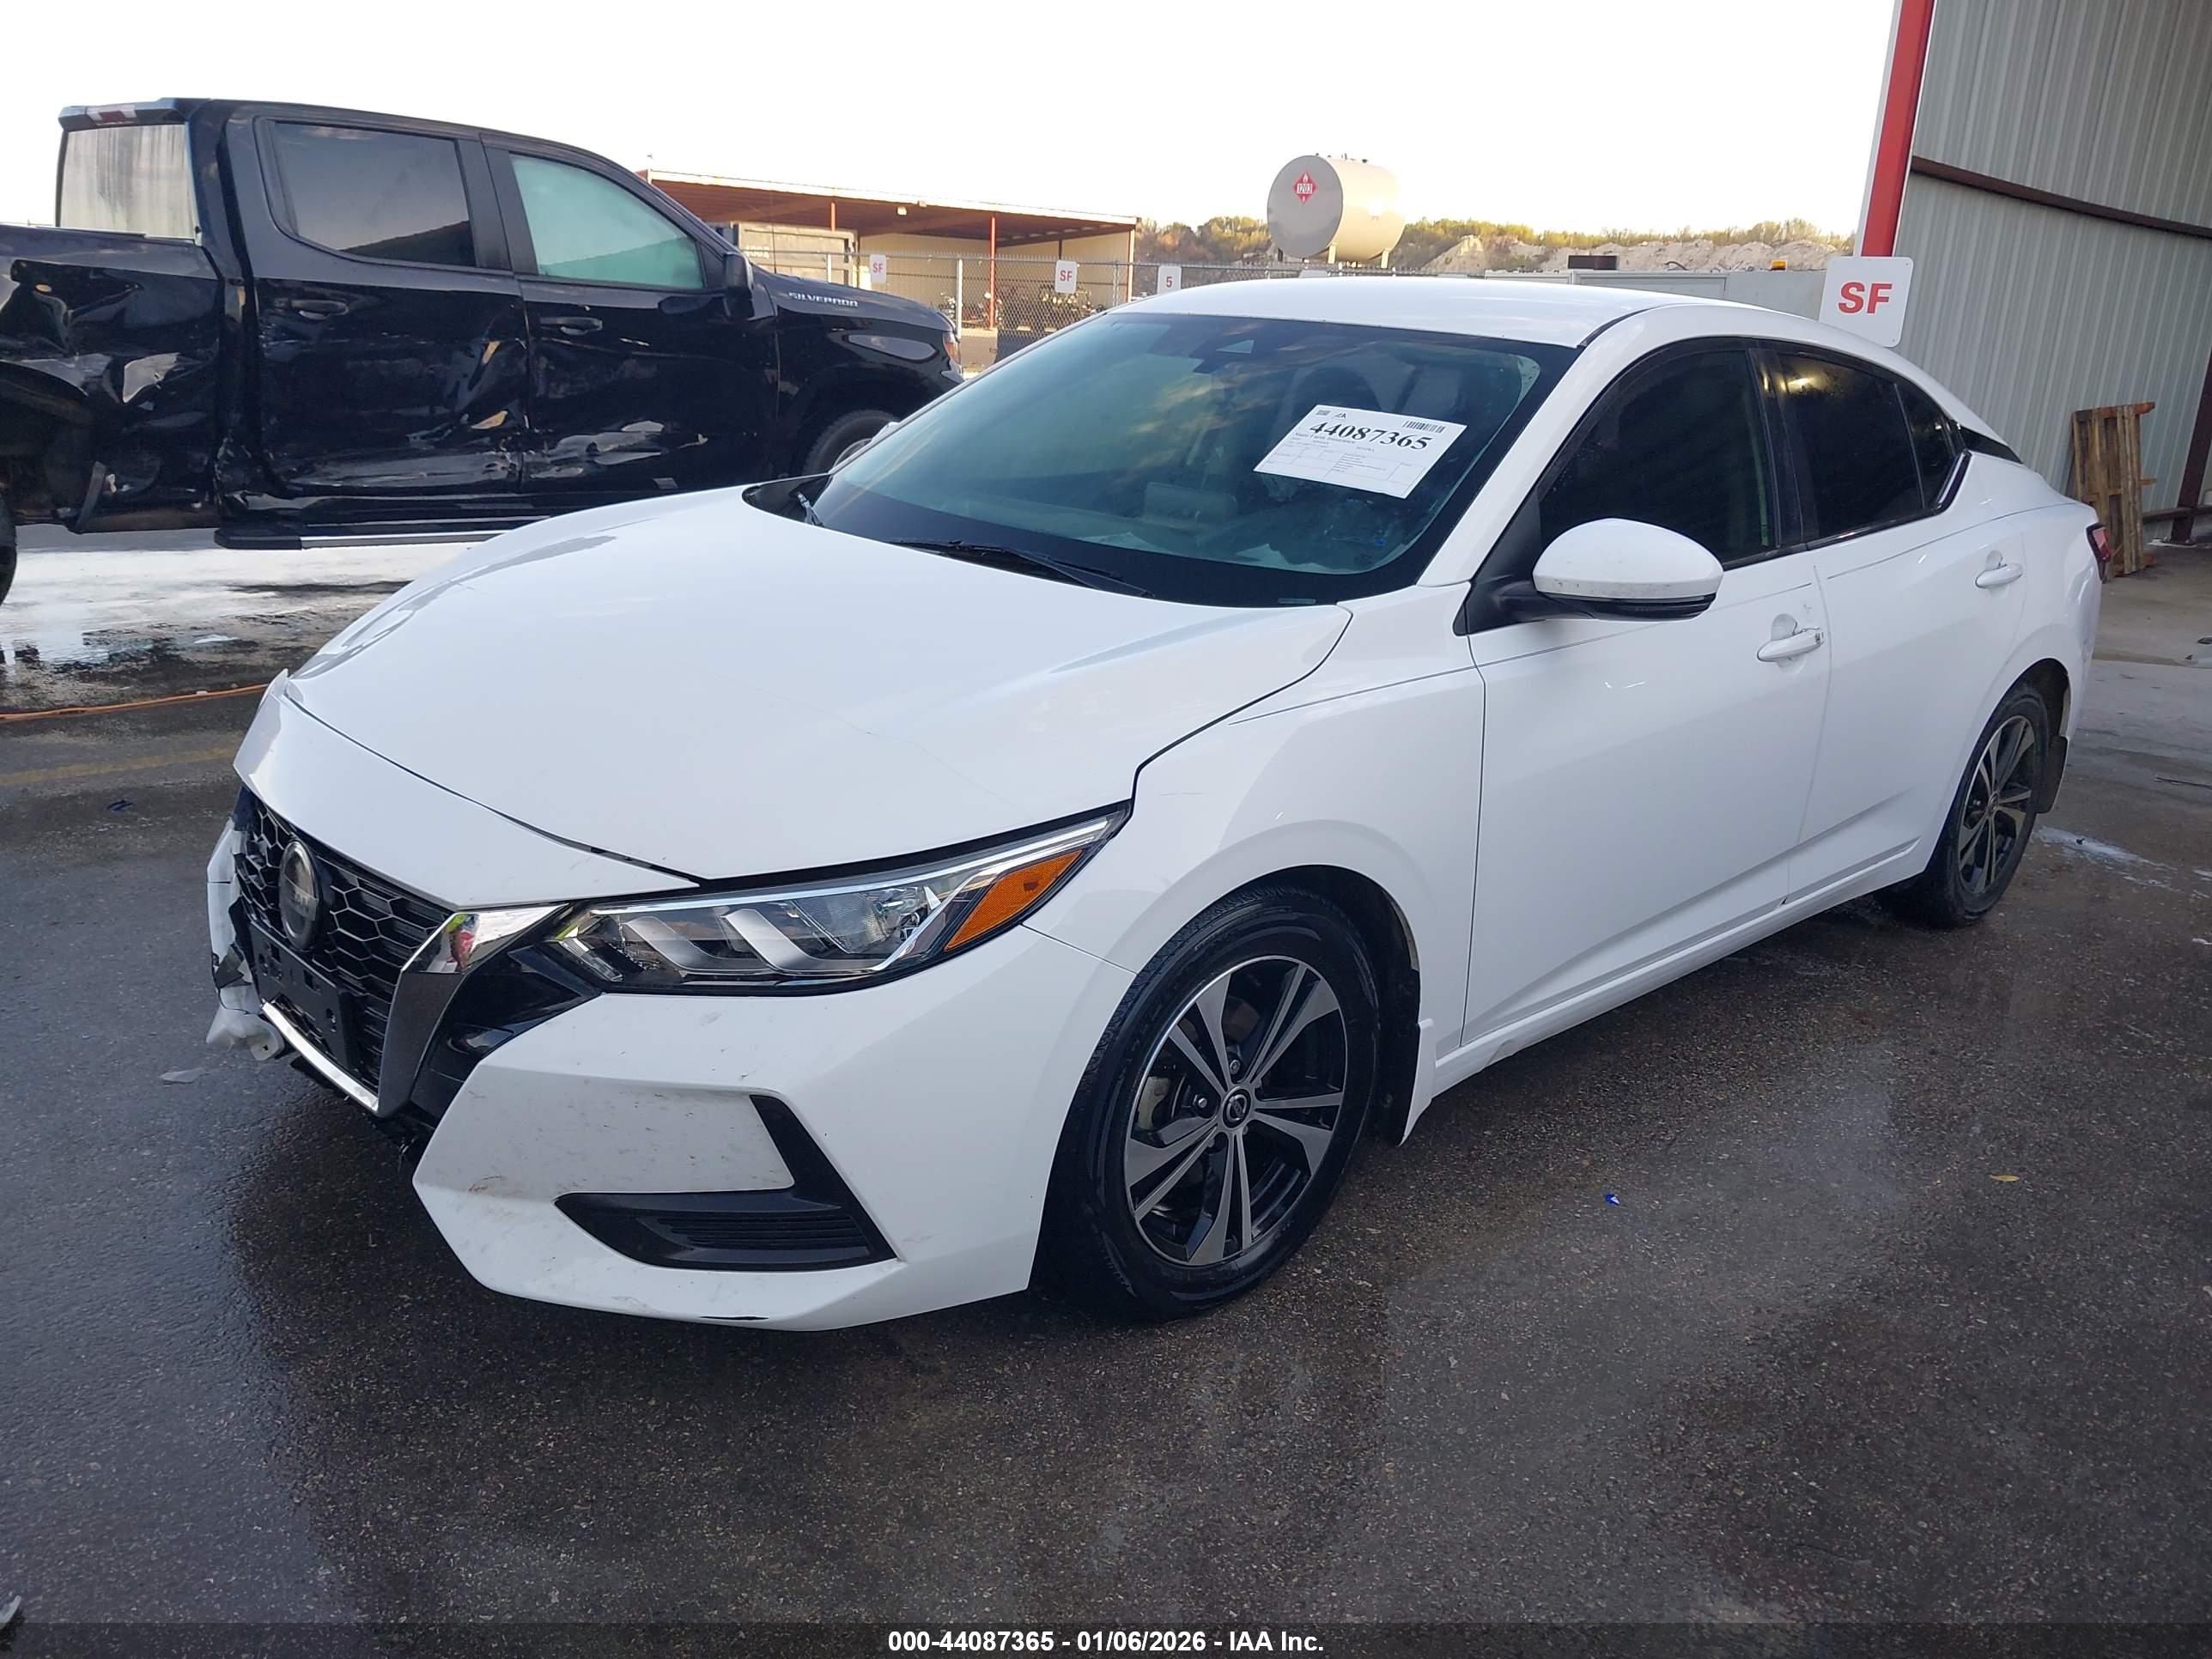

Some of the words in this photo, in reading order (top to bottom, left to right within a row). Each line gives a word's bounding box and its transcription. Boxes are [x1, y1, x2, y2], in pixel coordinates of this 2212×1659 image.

[872, 262, 884, 274] SF
[1060, 270, 1073, 283] SF
[1166, 276, 1173, 288] 5
[1838, 281, 1893, 314] SF
[1310, 422, 1432, 451] 44087365
